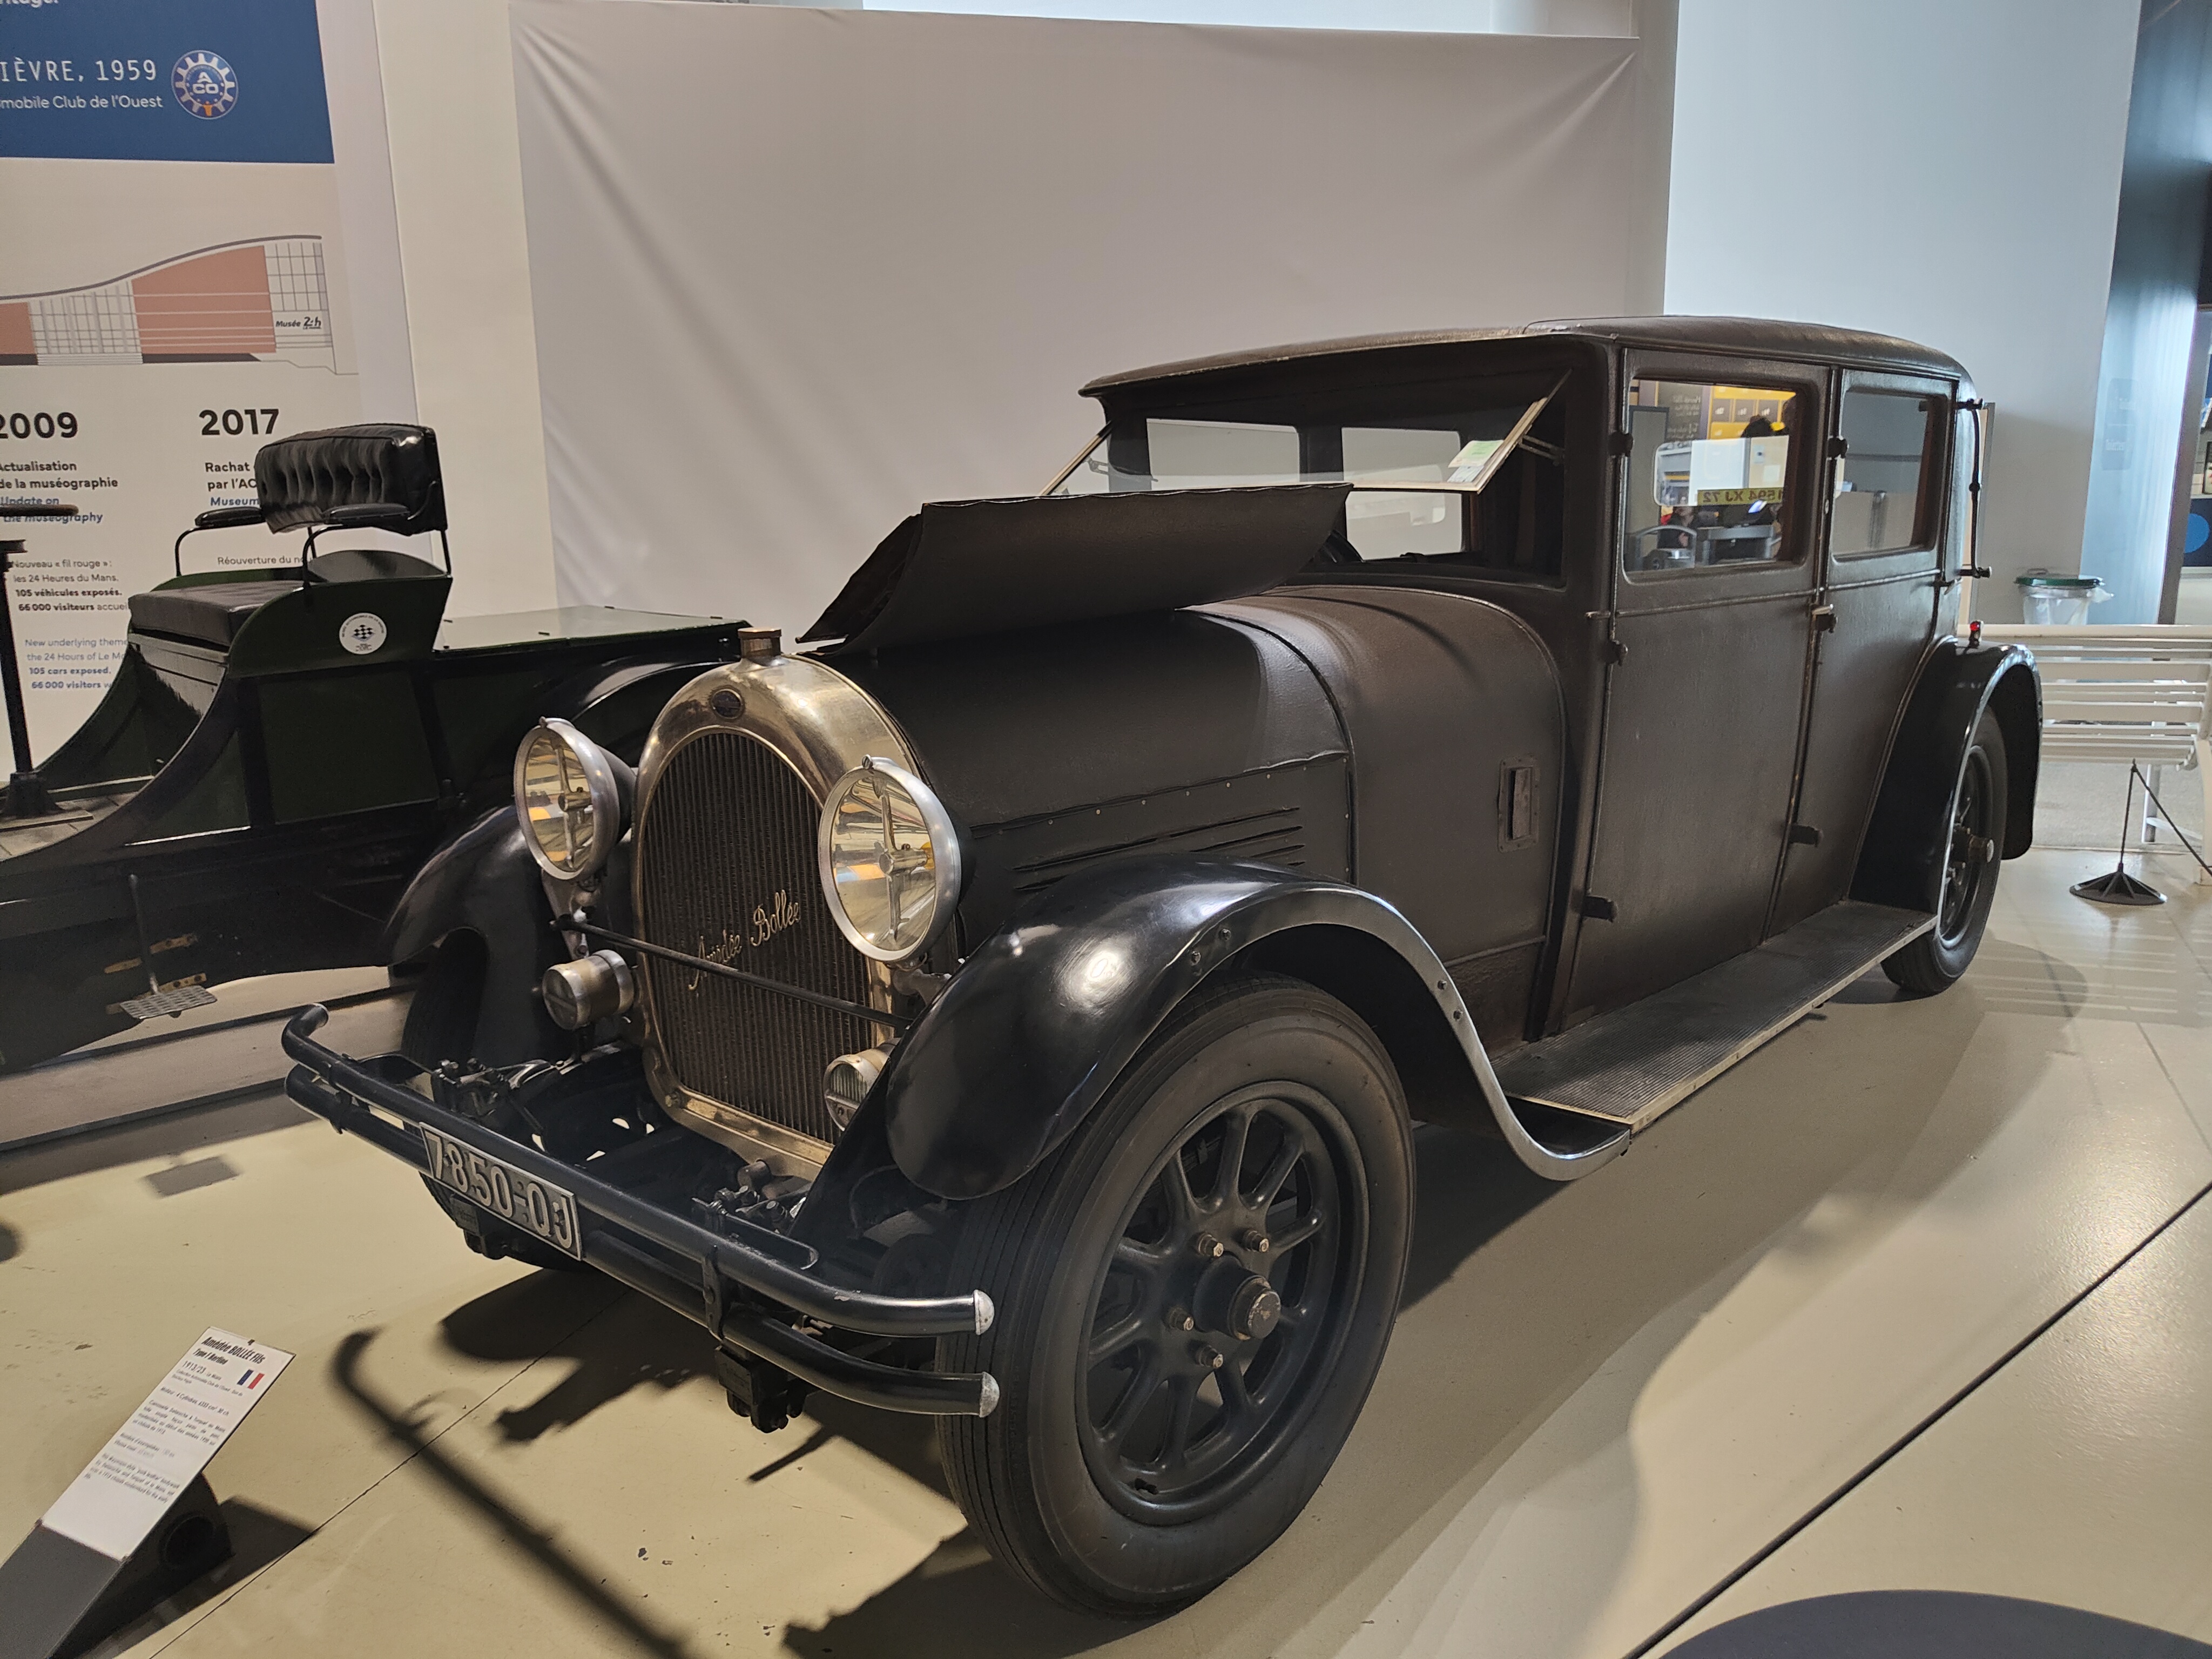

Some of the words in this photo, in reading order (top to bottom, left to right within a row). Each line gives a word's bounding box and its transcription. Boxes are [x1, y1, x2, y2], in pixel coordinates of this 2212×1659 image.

[95, 59, 157, 81] 1959
[52, 96, 87, 109] Club
[90, 95, 109, 108] de
[111, 95, 164, 108] l'Ouest
[199, 409, 279, 435] 2017
[205, 462, 250, 473] Rachat
[0, 478, 12, 489] de
[16, 478, 26, 489] la
[30, 476, 118, 490] muséographie
[207, 481, 228, 492] par
[73, 561, 100, 569] rouge
[217, 556, 276, 565] Réouverture
[279, 555, 292, 564] du
[42, 574, 75, 582] Heures
[34, 589, 79, 597] véhicules
[53, 602, 95, 611] visiteurs
[48, 638, 97, 648] underlying
[66, 680, 102, 689] visitors
[201, 1337, 231, 1352] Amédée
[227, 1345, 256, 1360] BOLLÉE
[248, 1351, 266, 1364] Fils
[182, 1360, 207, 1374] 1913/23
